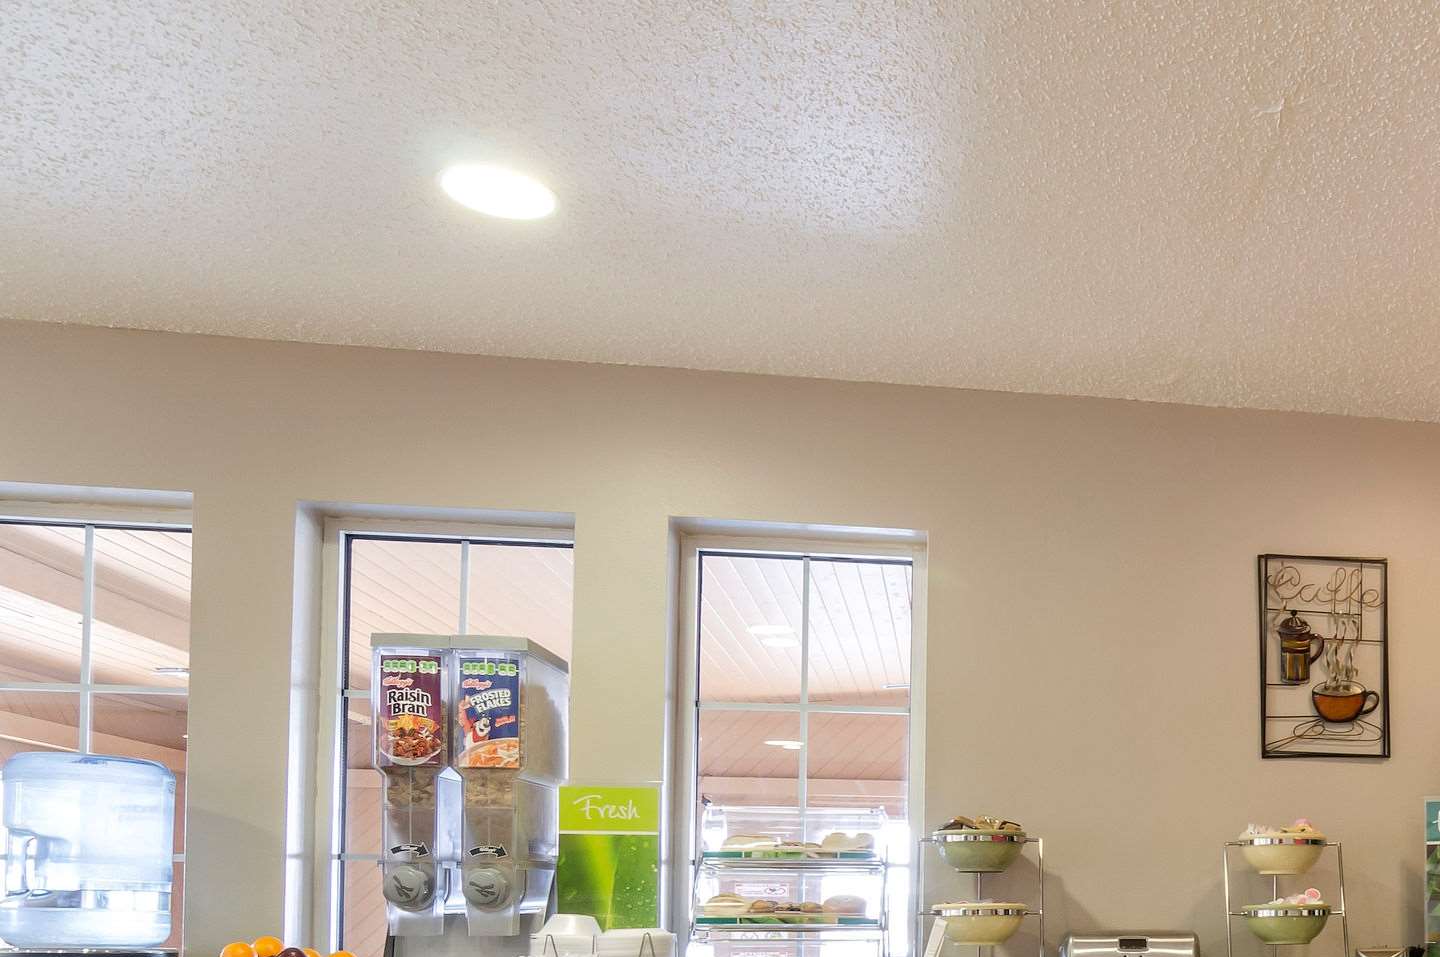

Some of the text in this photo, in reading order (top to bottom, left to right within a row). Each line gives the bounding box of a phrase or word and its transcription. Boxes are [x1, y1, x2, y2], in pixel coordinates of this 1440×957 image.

[387, 688, 432, 706] Raisin
[470, 688, 512, 706] FROSTED
[476, 697, 512, 713] FLAKES
[392, 701, 428, 716] Bran
[572, 794, 640, 820] Fresh
